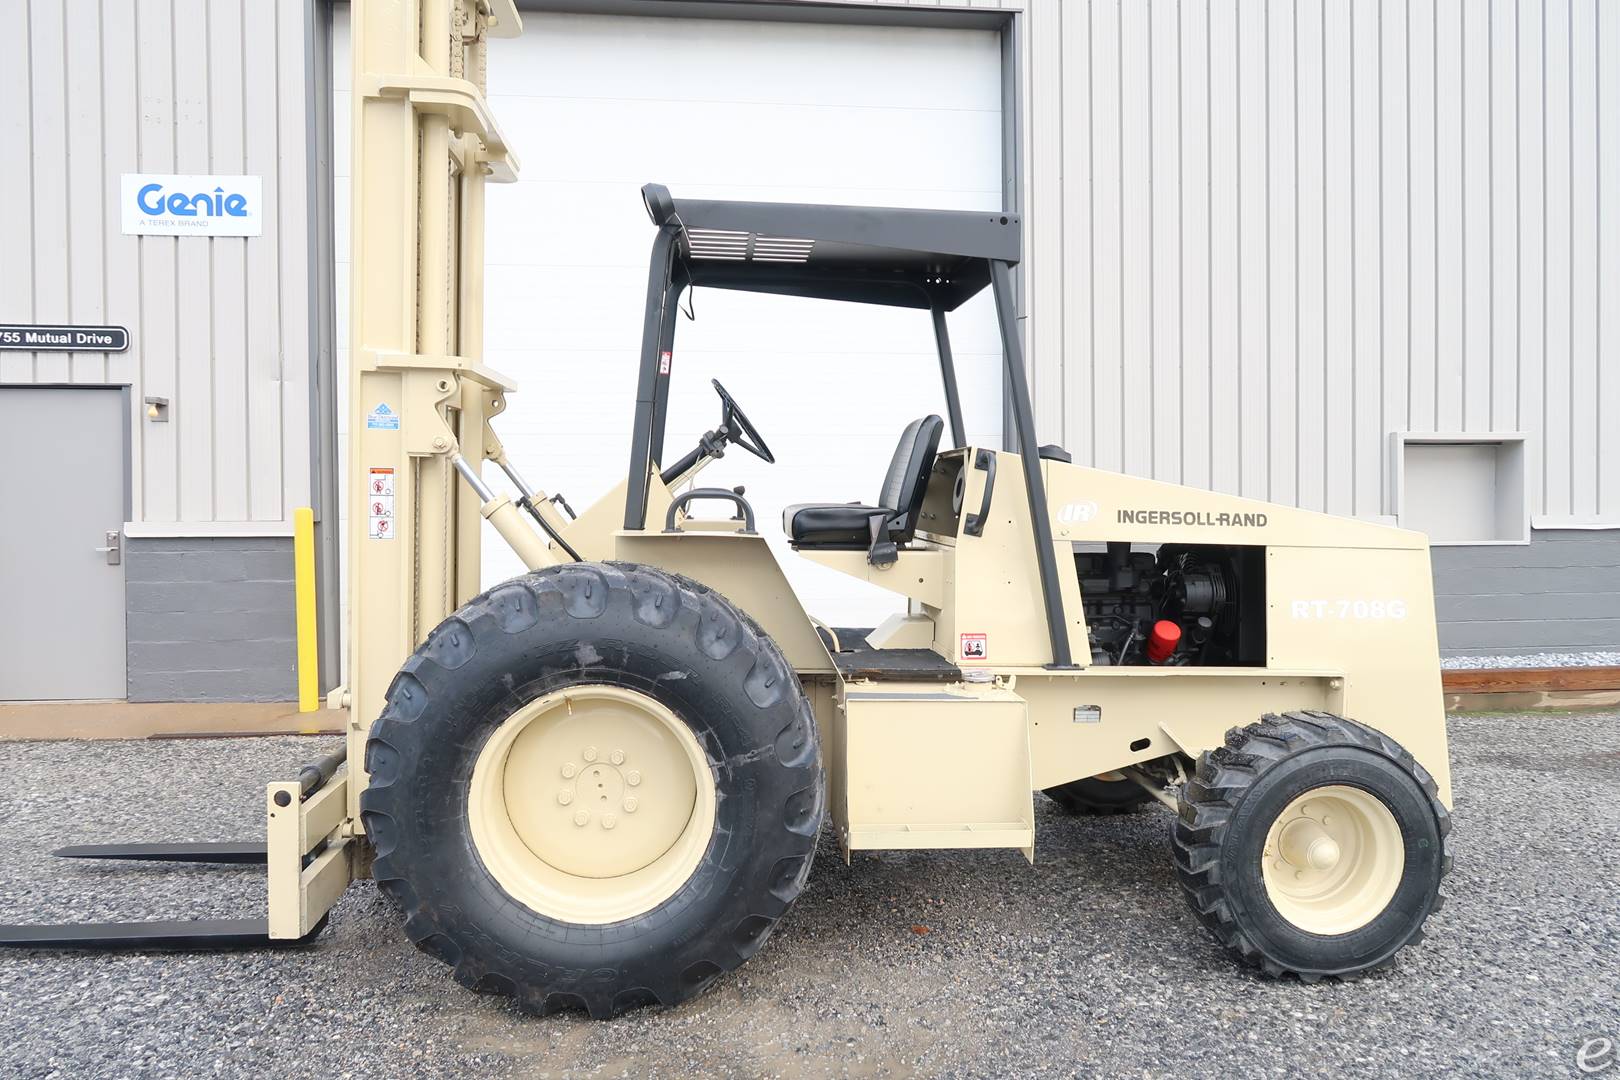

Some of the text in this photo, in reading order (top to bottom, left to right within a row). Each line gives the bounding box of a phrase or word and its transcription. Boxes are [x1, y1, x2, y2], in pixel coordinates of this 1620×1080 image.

[149, 219, 175, 227] TEREX
[25, 332, 71, 343] Mutual
[76, 333, 112, 344] Drive
[1117, 510, 1268, 527] INGERSOLL-RAND
[1291, 600, 1407, 620] RT-708G
